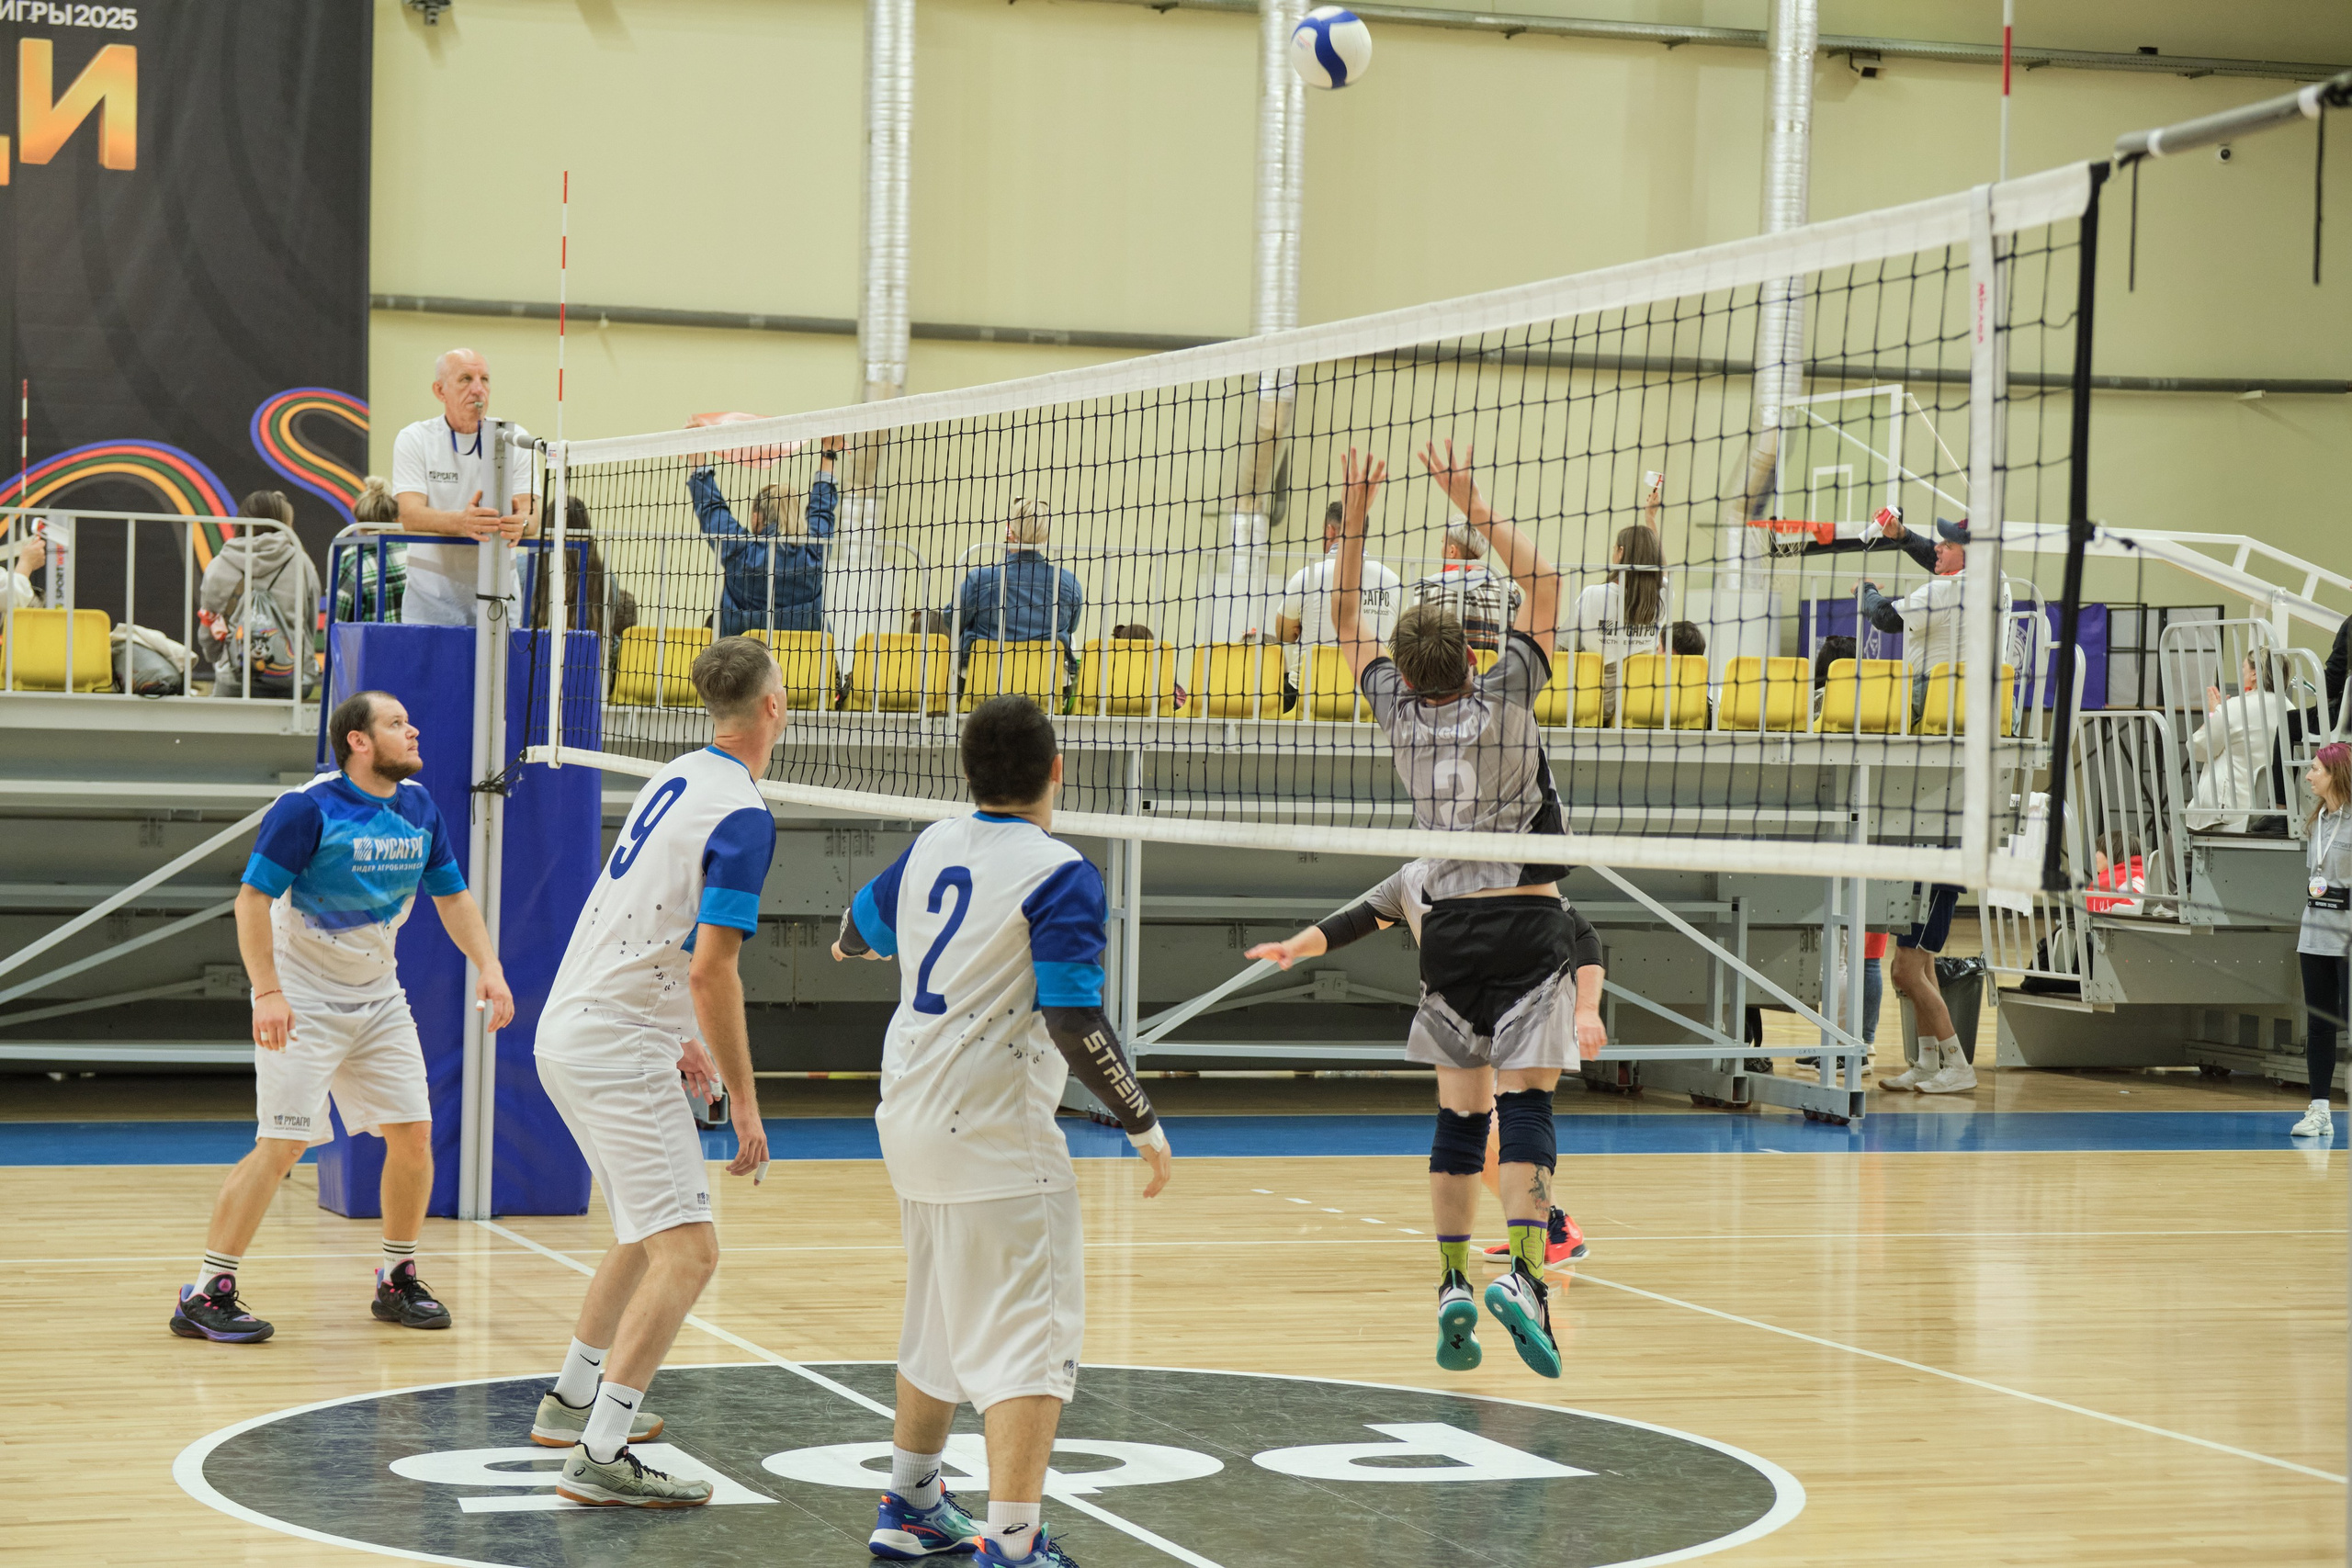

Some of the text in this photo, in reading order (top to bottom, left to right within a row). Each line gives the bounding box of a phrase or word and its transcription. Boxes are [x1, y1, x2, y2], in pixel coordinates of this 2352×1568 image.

[0, 0, 138, 30] ИГРЫ2025
[0, 38, 137, 186] И
[1363, 590, 1390, 607] САГРО
[609, 776, 687, 880] 9
[351, 864, 376, 874] ЛИДЕР
[912, 865, 974, 1015] 2
[1082, 1029, 1150, 1119] STREIN
[284, 1115, 311, 1127] РУСАГРО
